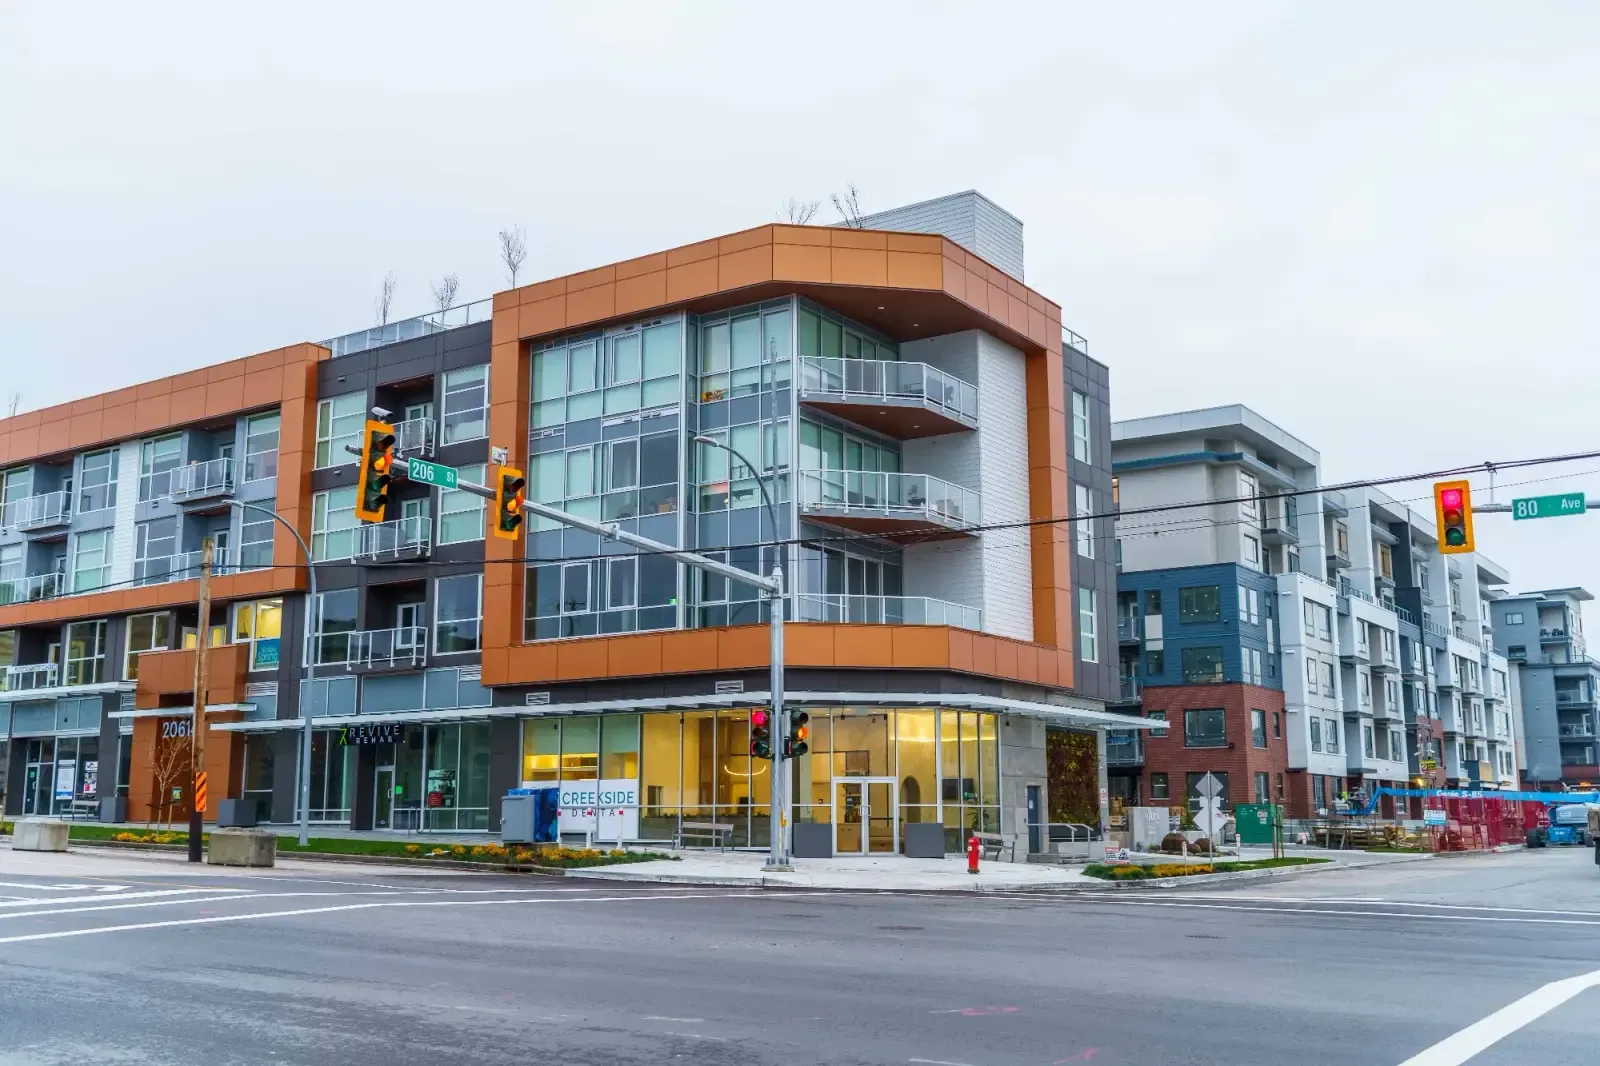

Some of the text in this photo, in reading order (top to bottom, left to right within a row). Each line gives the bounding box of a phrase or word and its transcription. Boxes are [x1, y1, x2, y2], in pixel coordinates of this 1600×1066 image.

[412, 461, 454, 483] 206 St
[1518, 498, 1581, 517] 80 Ave
[349, 725, 400, 737] REVIVE
[355, 736, 393, 744] REHAB
[562, 791, 635, 805] CREEKSIDE
[572, 809, 624, 817] DENTA
